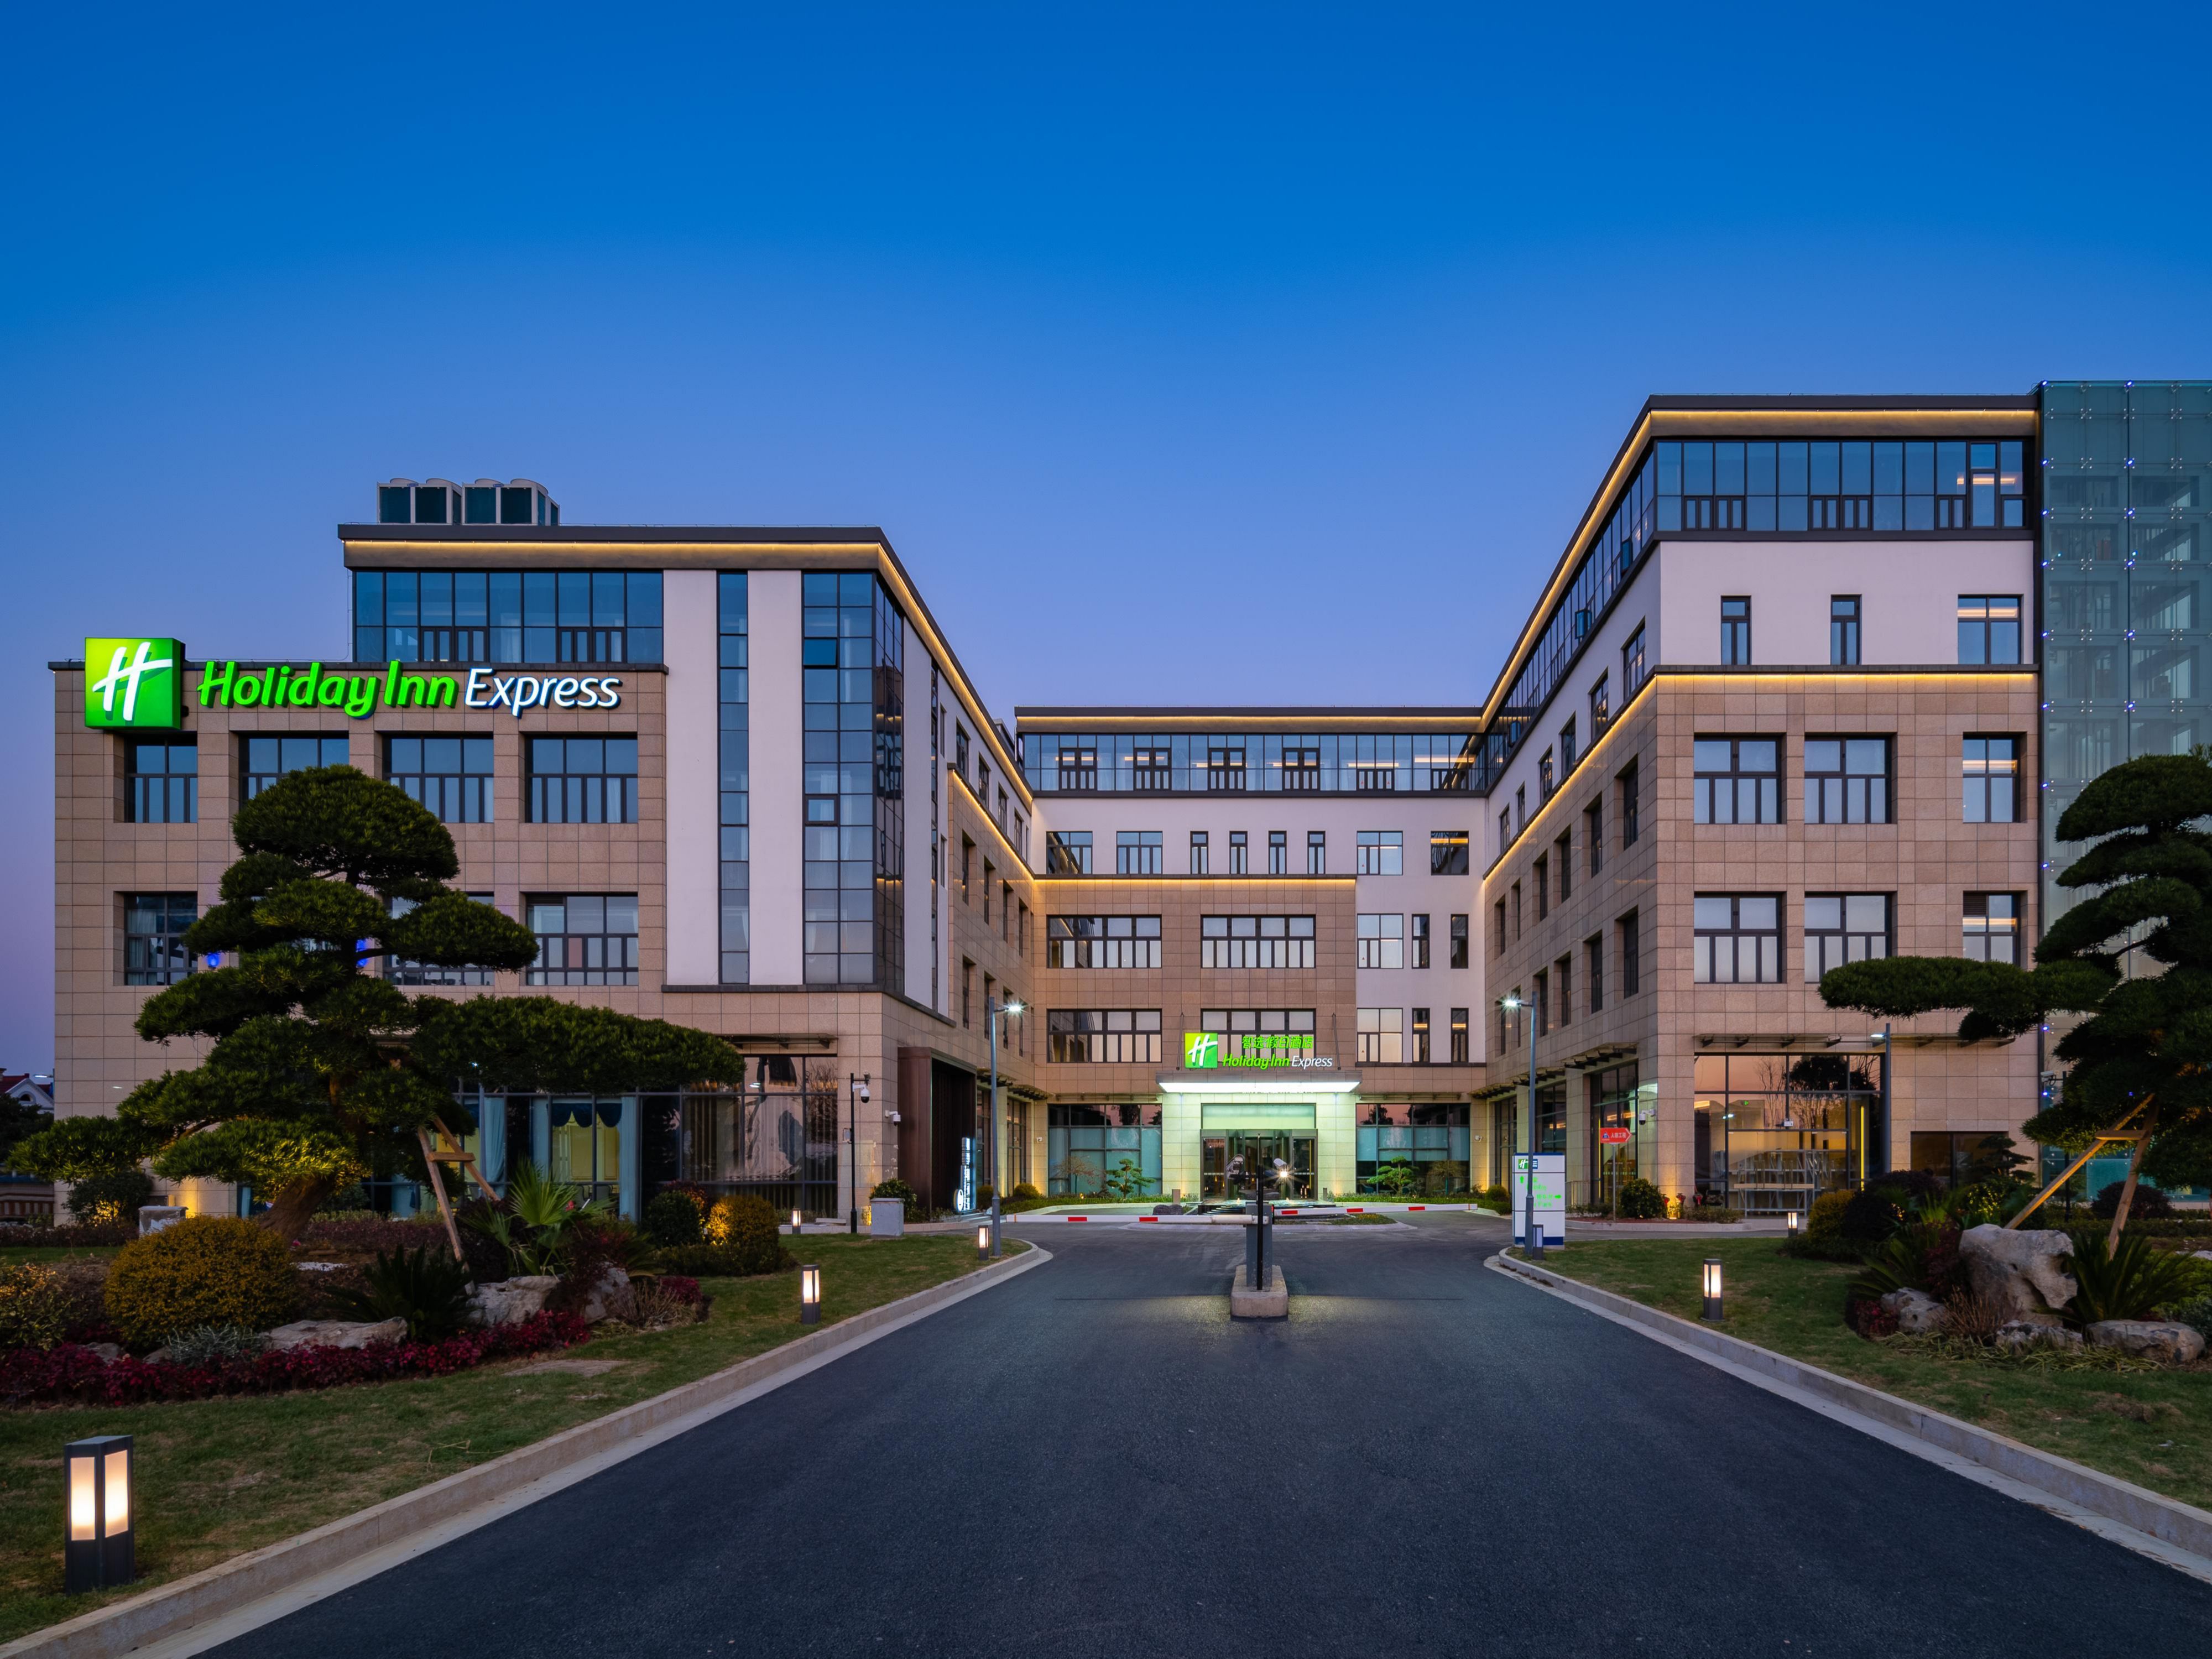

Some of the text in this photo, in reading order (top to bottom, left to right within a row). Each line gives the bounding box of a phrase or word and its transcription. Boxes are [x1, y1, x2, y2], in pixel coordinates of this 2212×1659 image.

[197, 660, 622, 719] Holiday Inn Express
[1242, 1036, 1313, 1048] 智选假日酒店
[1222, 1053, 1333, 1070] Holiday Inn Express
